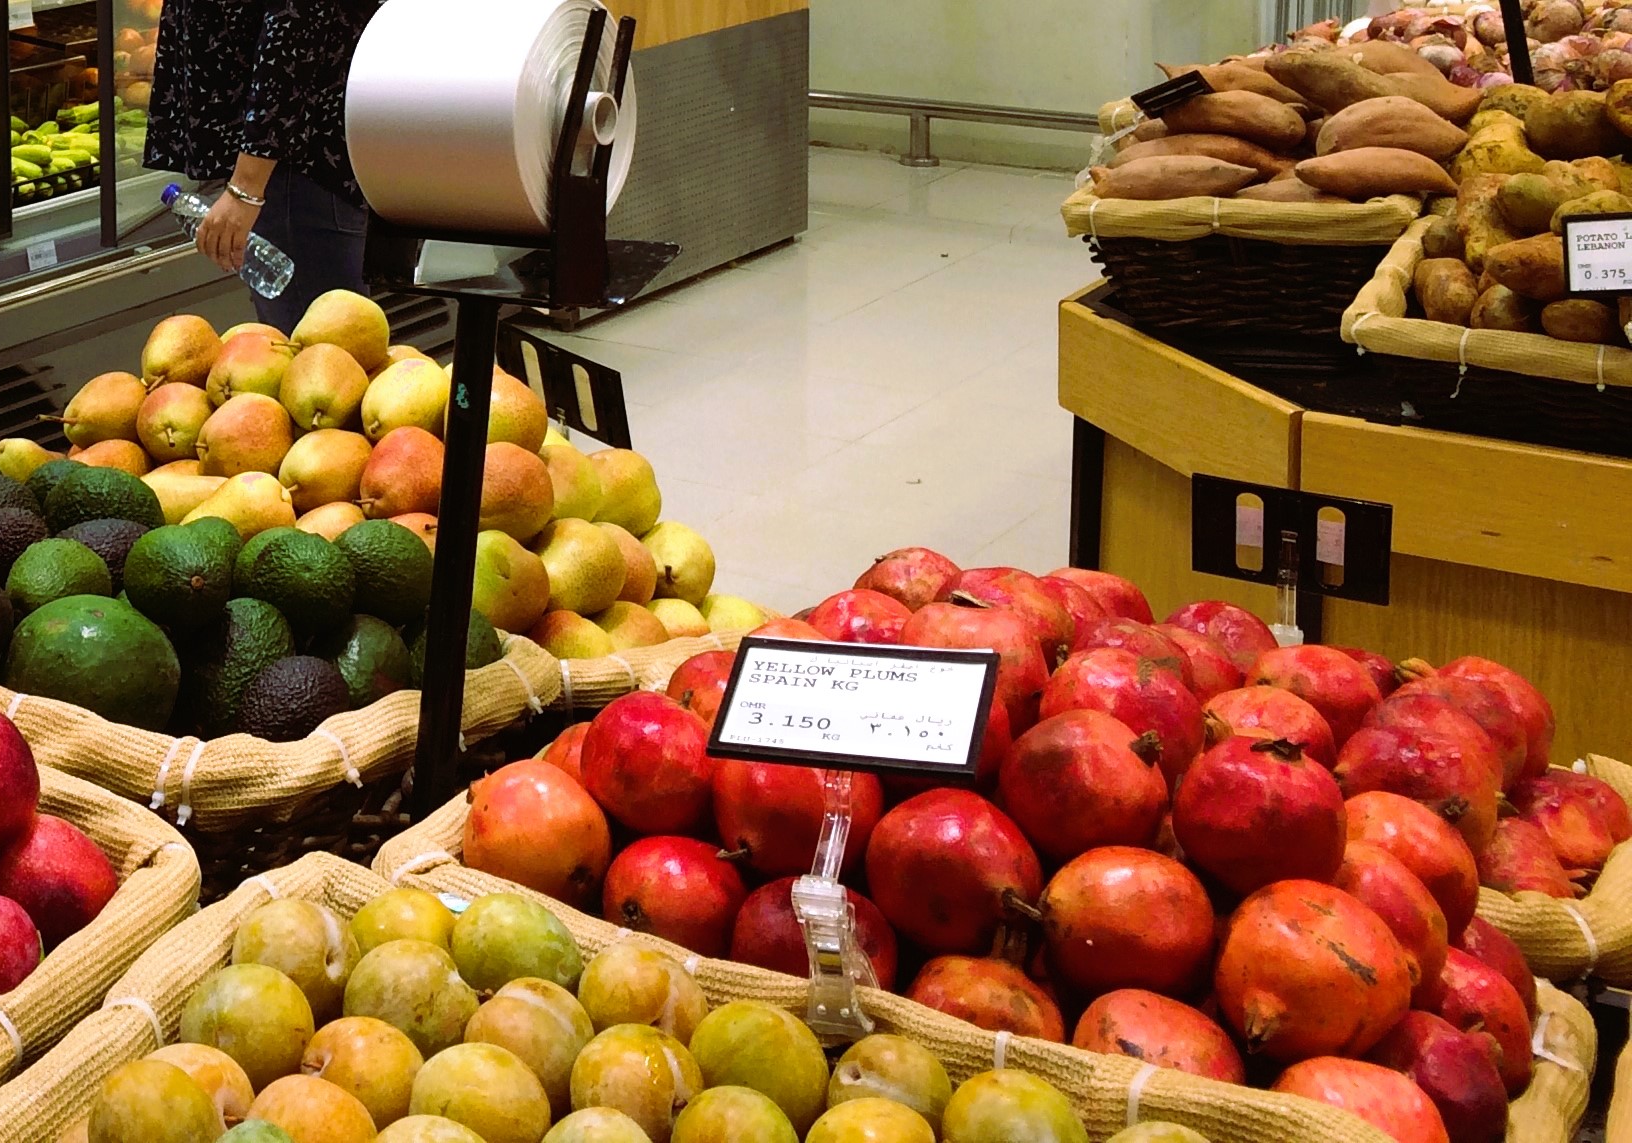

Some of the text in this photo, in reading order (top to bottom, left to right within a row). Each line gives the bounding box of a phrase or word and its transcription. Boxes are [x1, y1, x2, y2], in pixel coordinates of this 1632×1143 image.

[1576, 233, 1618, 242] POTATO
[1577, 242, 1625, 251] LEBANON
[1584, 268, 1626, 279] 0.375
[754, 660, 918, 683] YELLOW PLUMS
[748, 673, 859, 692] SPAIN KG
[739, 700, 767, 710] OMR
[748, 711, 832, 731] 3.150
[822, 732, 841, 741] KG
